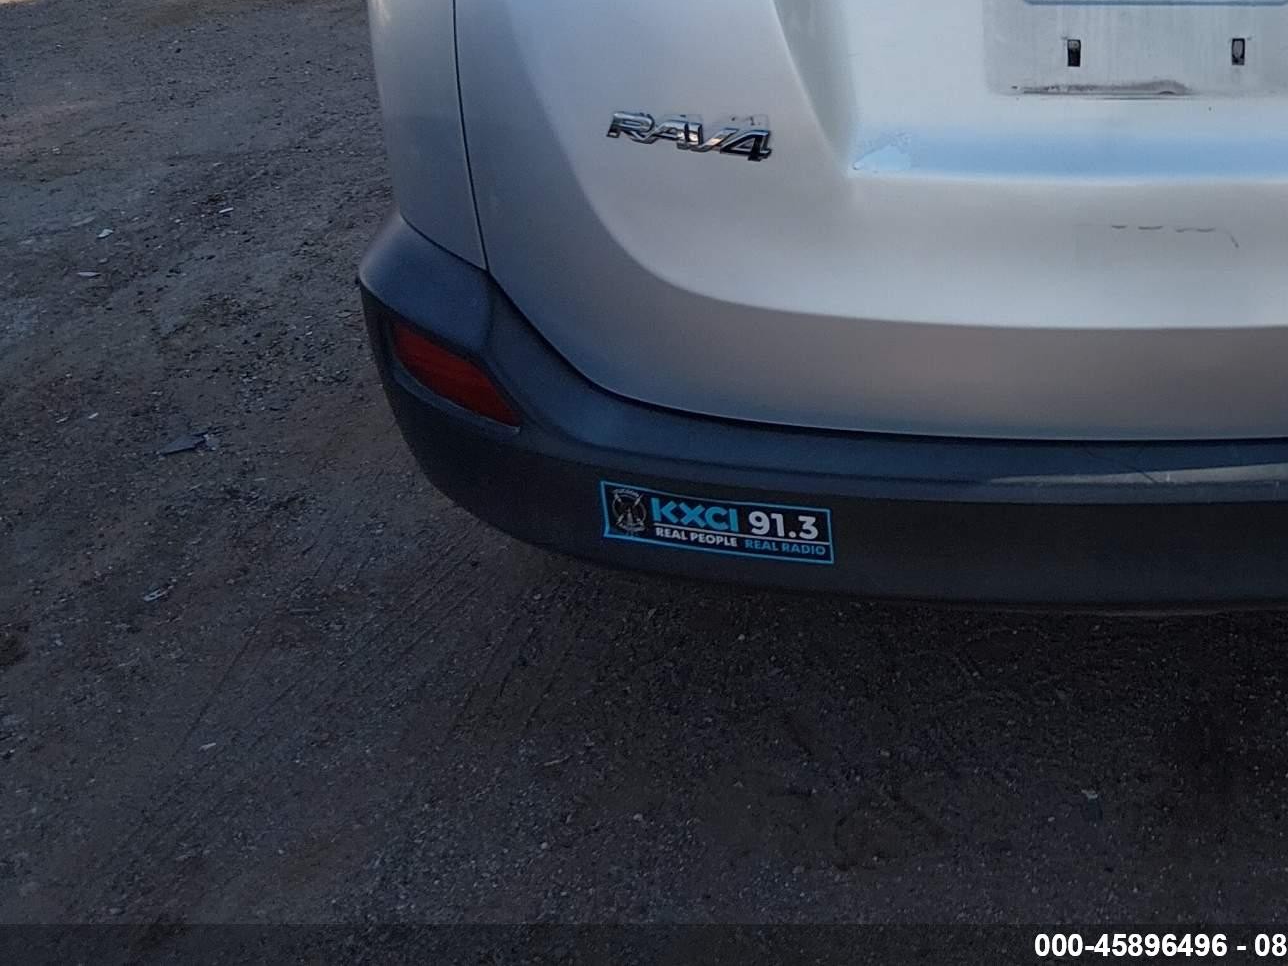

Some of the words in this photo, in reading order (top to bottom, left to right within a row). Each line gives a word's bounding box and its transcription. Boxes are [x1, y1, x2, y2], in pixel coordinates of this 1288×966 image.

[606, 111, 772, 162] RAV4
[651, 497, 740, 532] KXCI
[748, 511, 819, 540] 91.3
[655, 527, 688, 541] REAL
[690, 533, 738, 547] PEOPLE
[745, 539, 779, 552] REAL
[781, 542, 826, 556] RADIO
